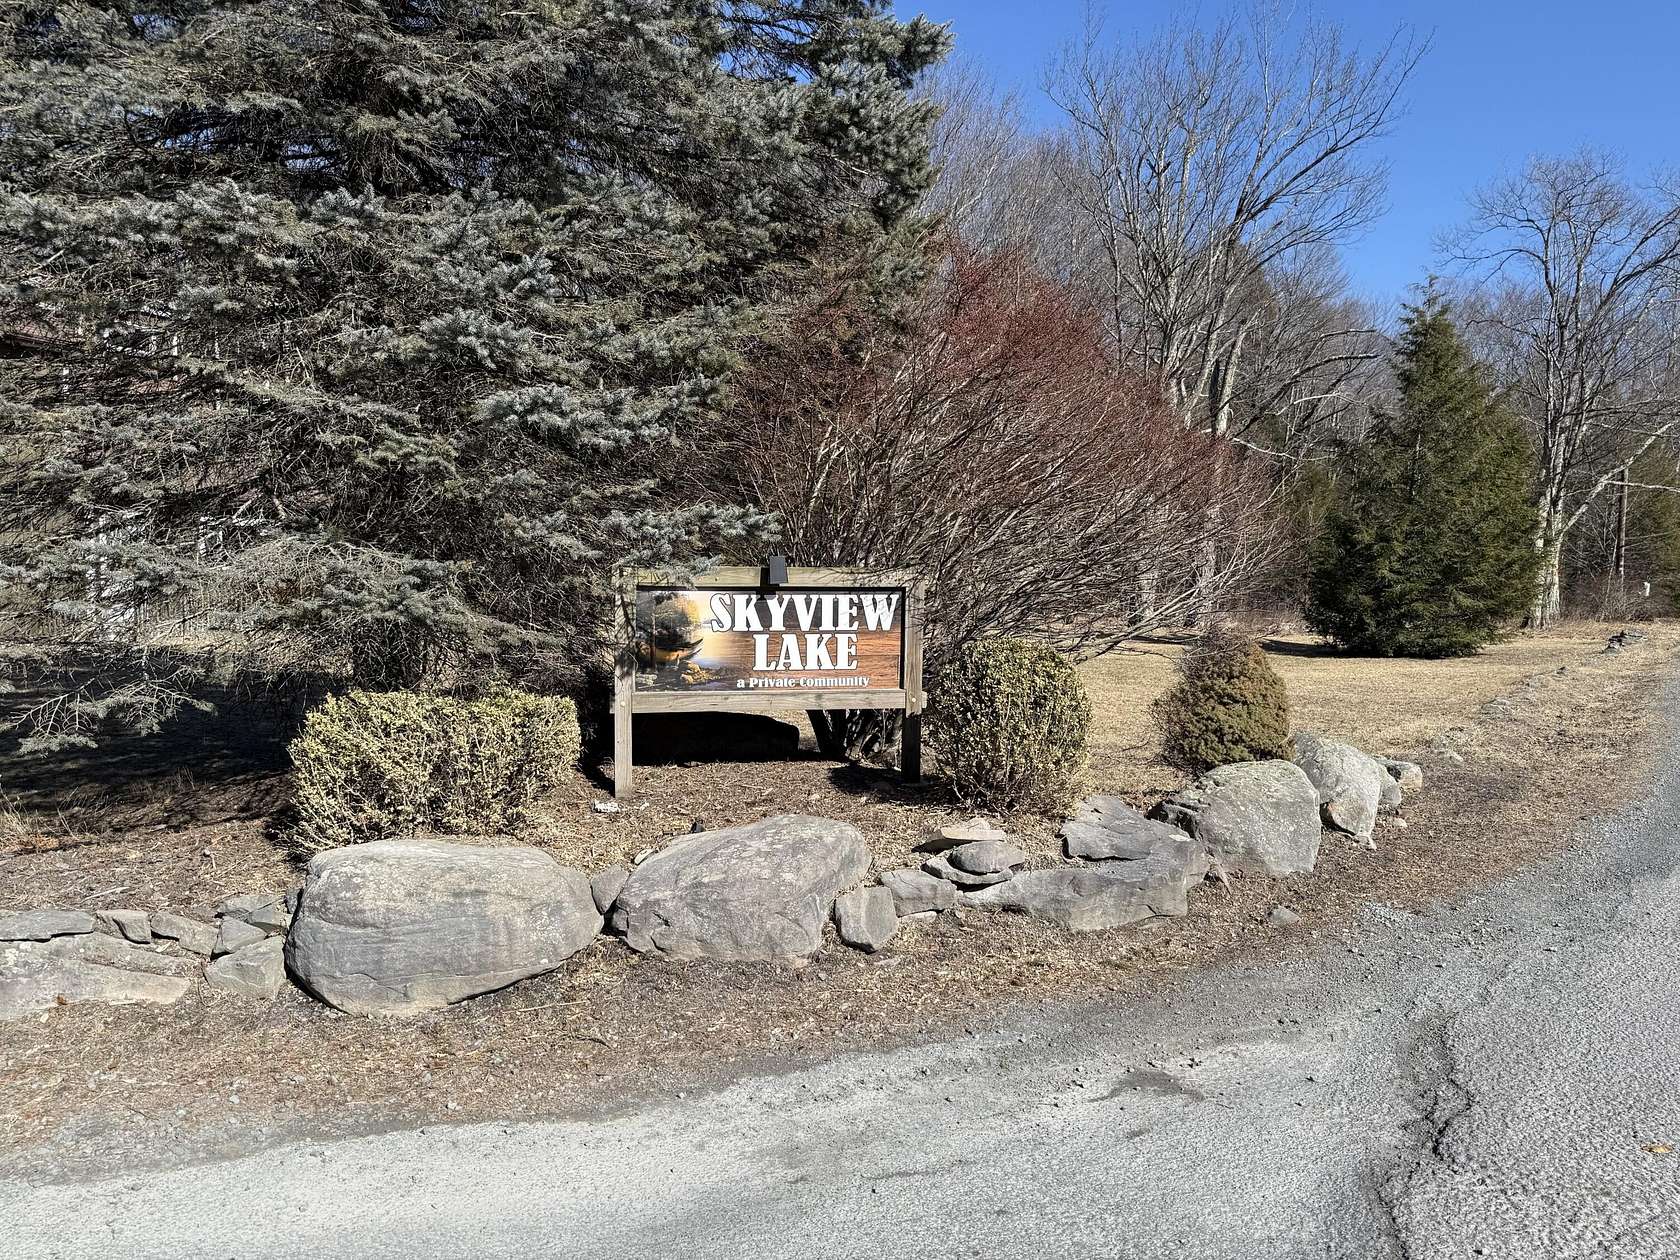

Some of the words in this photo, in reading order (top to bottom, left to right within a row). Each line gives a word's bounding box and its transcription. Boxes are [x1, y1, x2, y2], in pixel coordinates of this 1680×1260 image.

[710, 593, 900, 632] SKYVIEW
[752, 633, 858, 671] LAKE
[736, 680, 745, 688] a
[749, 677, 796, 688] Private
[799, 676, 870, 689] Community
